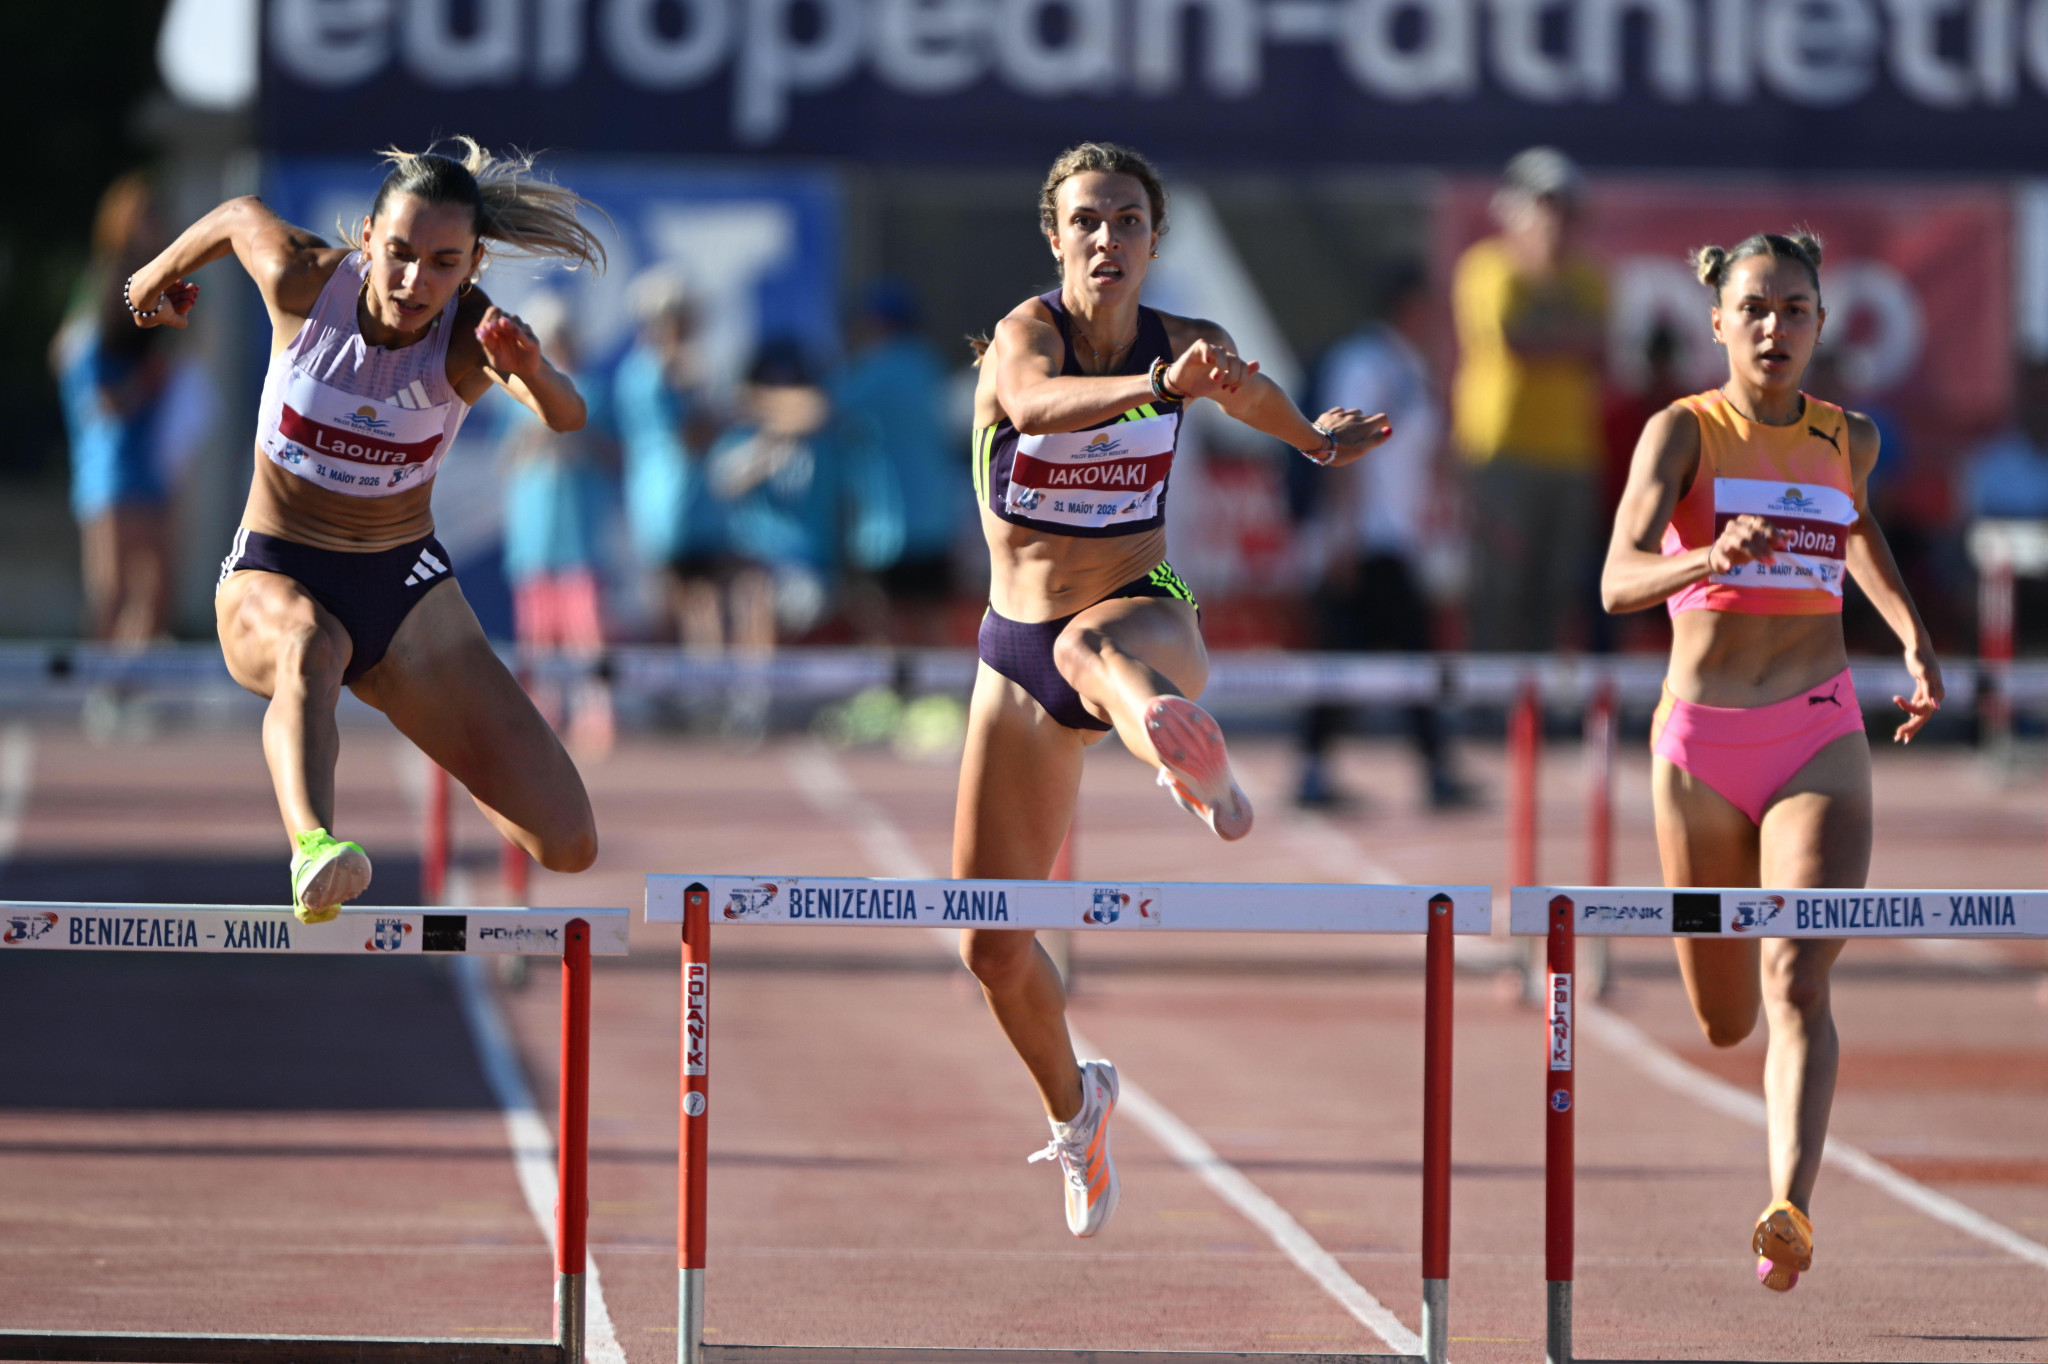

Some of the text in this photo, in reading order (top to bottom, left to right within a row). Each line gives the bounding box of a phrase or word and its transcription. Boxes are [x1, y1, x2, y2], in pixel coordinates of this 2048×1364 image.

[265, 0, 2048, 140] european-athleti
[333, 417, 396, 437] PILOT BEACH RESORT
[315, 429, 408, 464] Laoura
[316, 464, 326, 476] 31
[359, 476, 380, 486] 2026
[1048, 463, 1147, 486] IAKOVAKI
[1054, 501, 1064, 512] 31
[1097, 504, 1117, 515] 2026
[1776, 525, 1836, 552] piona
[1757, 564, 1766, 574] 31
[1795, 566, 1813, 576] 2026
[789, 888, 917, 919] ΒΕΝΙΖΕΛΕΙΑ
[942, 890, 1008, 921] ΧΑΝΙΑ
[1796, 897, 1924, 929] ΒΕΝΙΖΕΛΕΙΑ
[1949, 896, 2016, 926] ΧΑΝΙΑ
[69, 917, 198, 947] ΒΕΝΙΖΕΛΕΙΑ
[223, 920, 290, 949] ΧΑΝΙΑ
[687, 966, 705, 1066] POLANIK
[1554, 977, 1569, 1061] POLANIK
